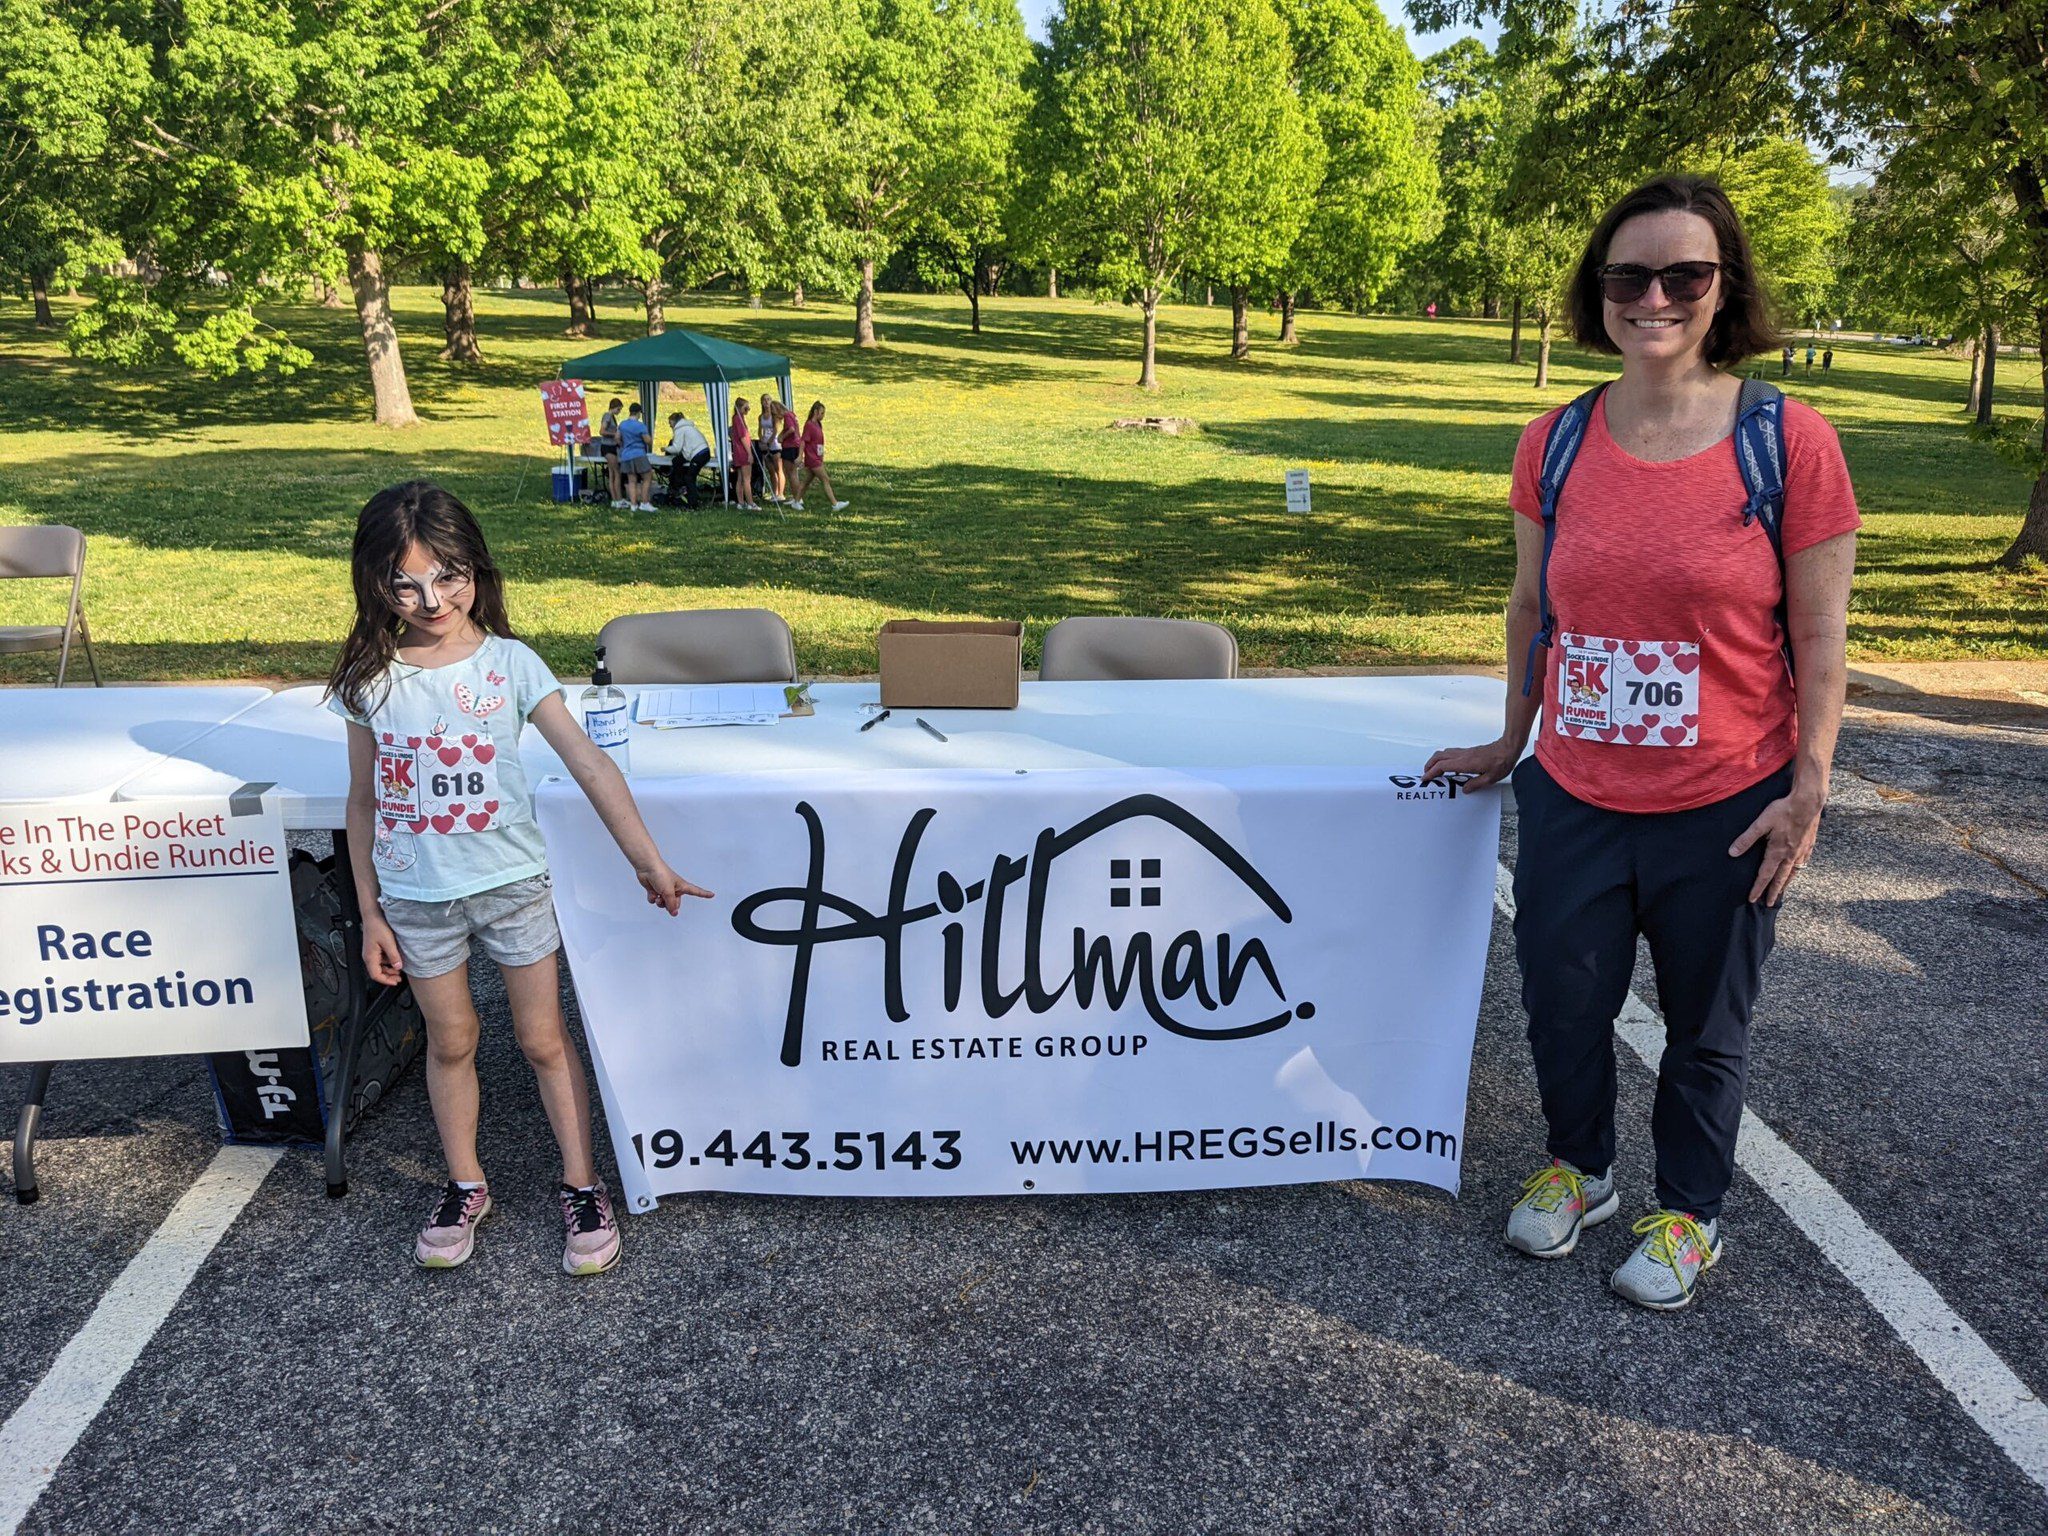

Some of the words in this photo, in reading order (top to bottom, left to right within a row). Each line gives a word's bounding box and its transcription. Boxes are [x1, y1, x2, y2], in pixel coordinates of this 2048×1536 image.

[550, 402, 568, 410] FIRST
[553, 409, 581, 417] STATION
[1567, 661, 1608, 694] 5K
[1626, 681, 1683, 706] 706
[592, 714, 615, 727] Hand
[1566, 706, 1606, 720] RUNDIE
[381, 757, 415, 788] 5K
[432, 772, 484, 797] 618
[382, 801, 415, 813] RUNDIE
[1397, 791, 1446, 800] REALTY
[24, 819, 52, 844] In
[57, 816, 115, 842] The
[124, 812, 226, 840] Pocket
[0, 850, 32, 876] ks
[41, 848, 62, 874] &
[70, 845, 160, 873] Undie
[168, 839, 275, 869] Rundie
[37, 924, 152, 961] Race
[822, 1040, 900, 1061] REAL
[912, 1037, 1022, 1060] ESTATE
[1035, 1035, 1148, 1057] GROUP
[1010, 1120, 1457, 1165] www.HREGSells.com
